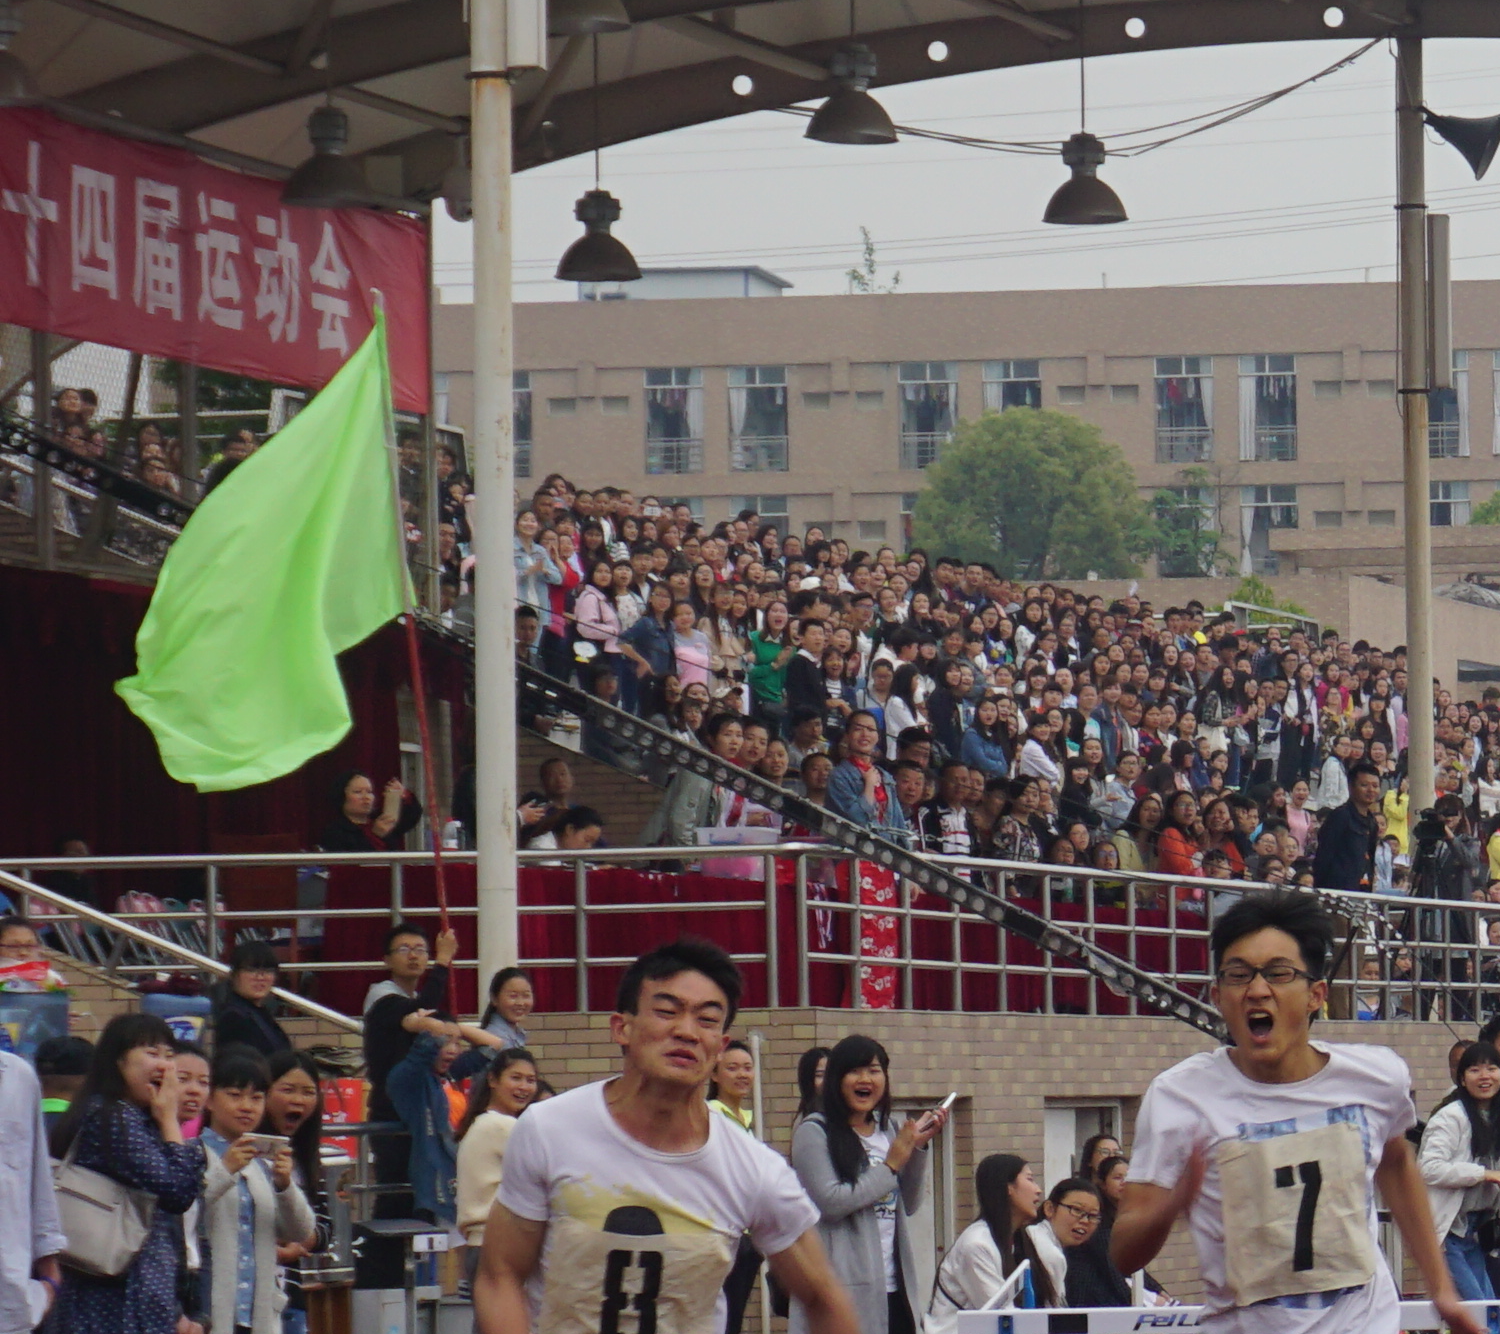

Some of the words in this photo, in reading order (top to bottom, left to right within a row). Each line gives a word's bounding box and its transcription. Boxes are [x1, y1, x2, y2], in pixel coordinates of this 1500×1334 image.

[1, 140, 352, 357] 十四届运动会
[1275, 1160, 1323, 1272] 7
